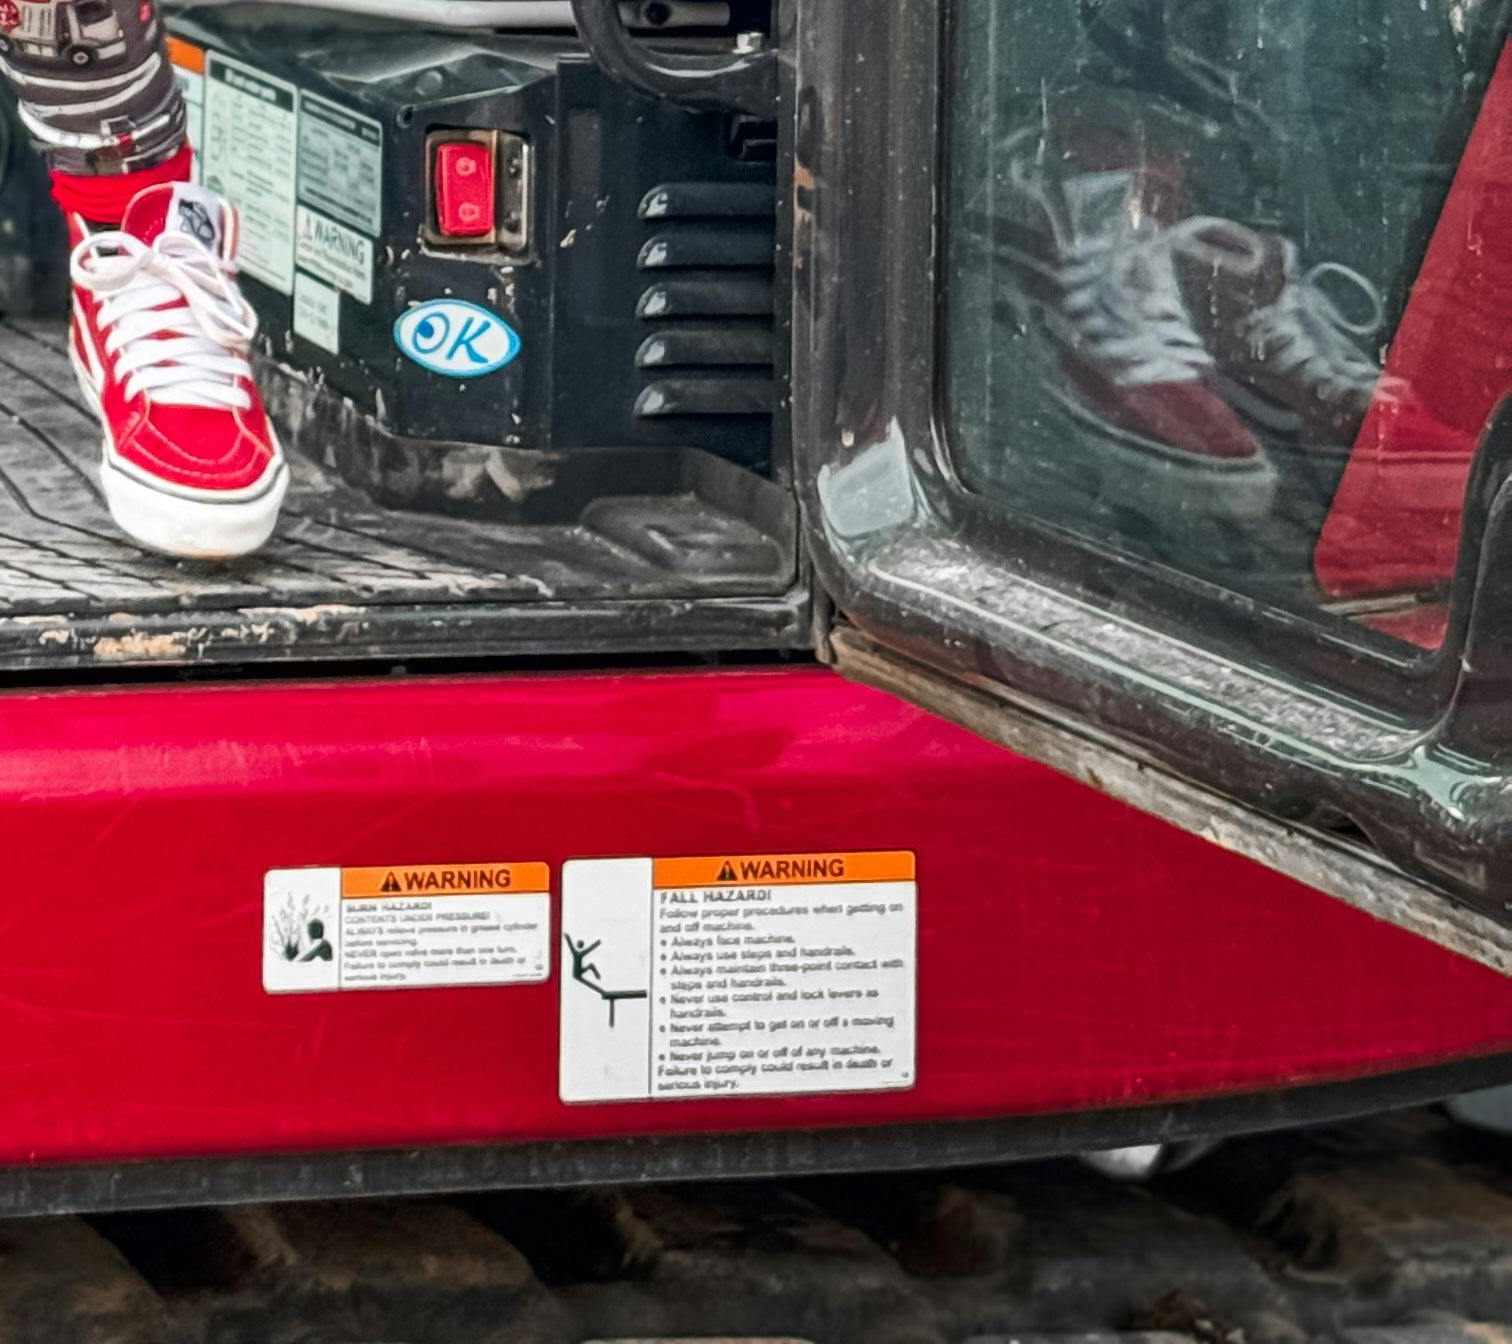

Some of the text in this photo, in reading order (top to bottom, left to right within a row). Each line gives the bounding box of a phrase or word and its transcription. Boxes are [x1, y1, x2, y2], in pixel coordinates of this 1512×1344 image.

[315, 219, 364, 265] WARNING
[412, 311, 491, 364] OK
[740, 859, 844, 879] WARNING
[404, 870, 511, 890] WARNING
[661, 889, 771, 904] FALL HAZARD!
[672, 936, 712, 948] Always
[672, 950, 712, 962] Always
[672, 965, 712, 977] Always
